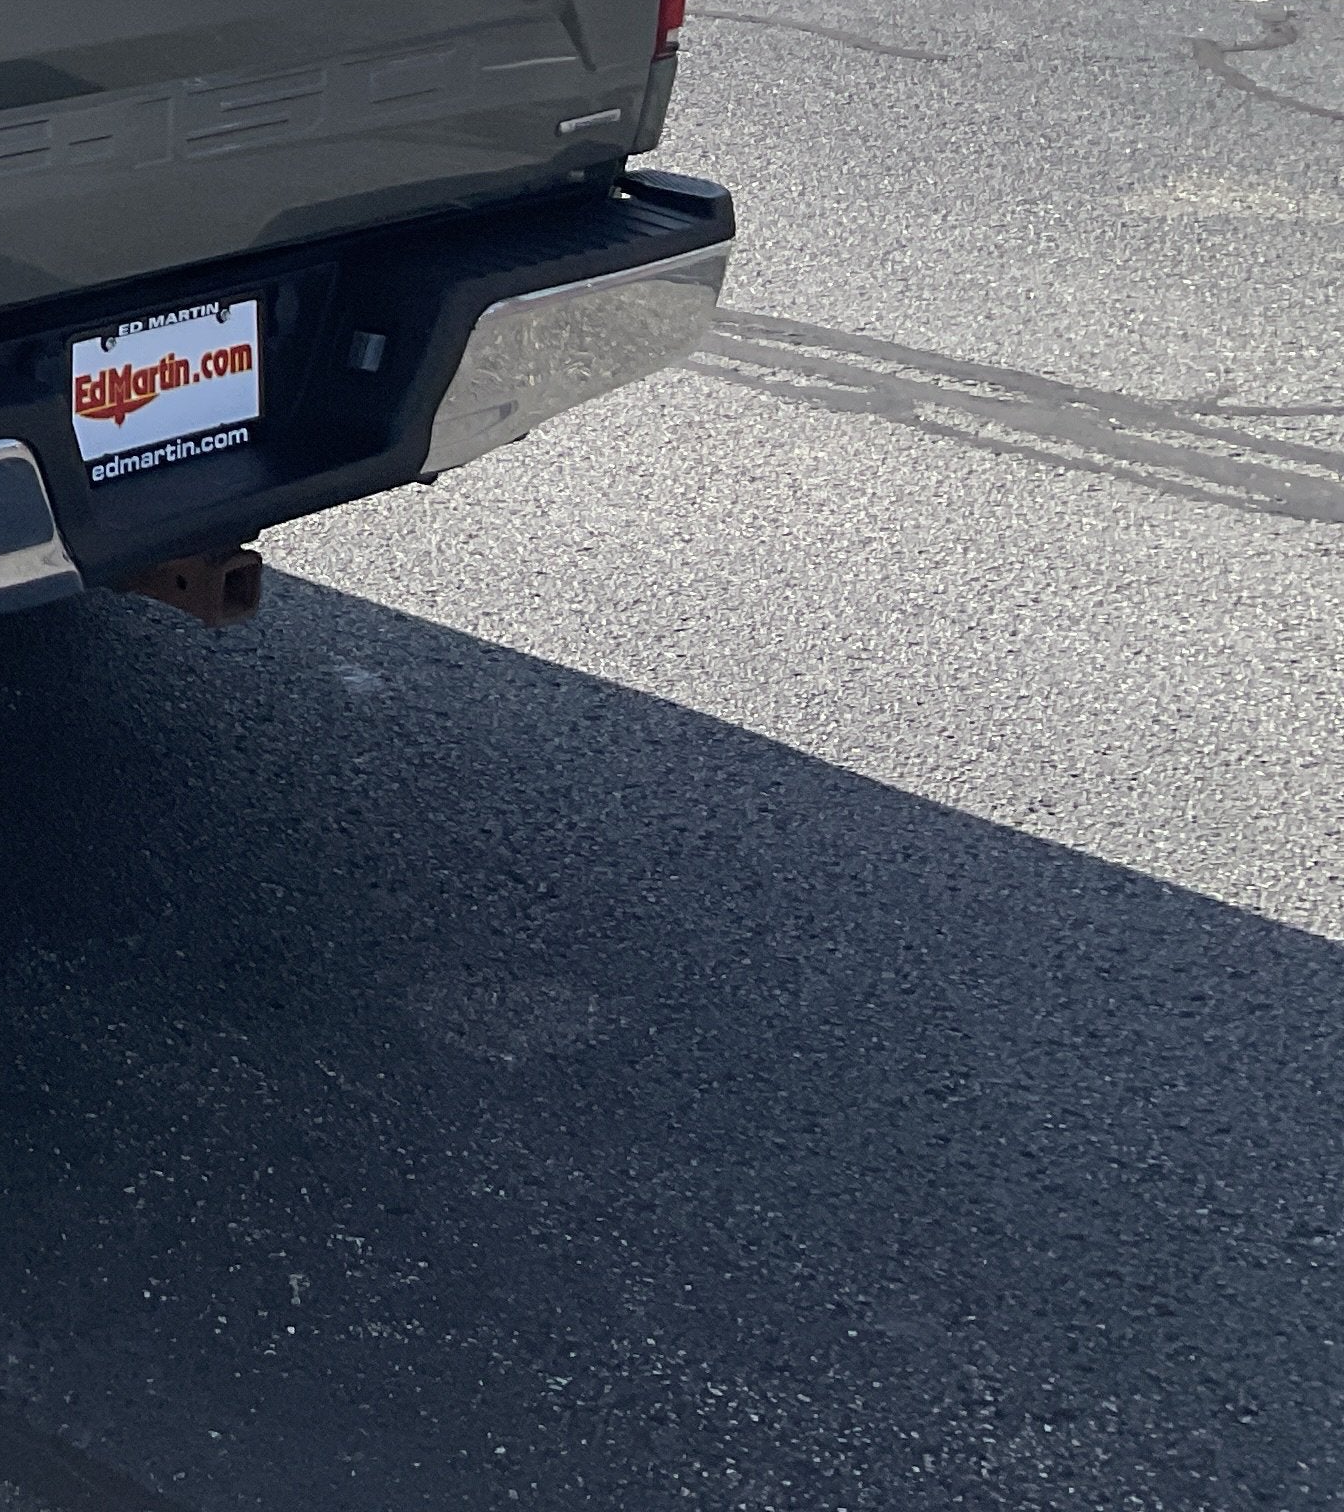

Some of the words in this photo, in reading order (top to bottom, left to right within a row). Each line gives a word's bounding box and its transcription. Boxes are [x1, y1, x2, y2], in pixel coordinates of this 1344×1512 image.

[118, 321, 143, 336] ED
[148, 301, 220, 329] MARTIN
[74, 343, 253, 415] EdMartin.com
[91, 427, 249, 482] edmartin.com
